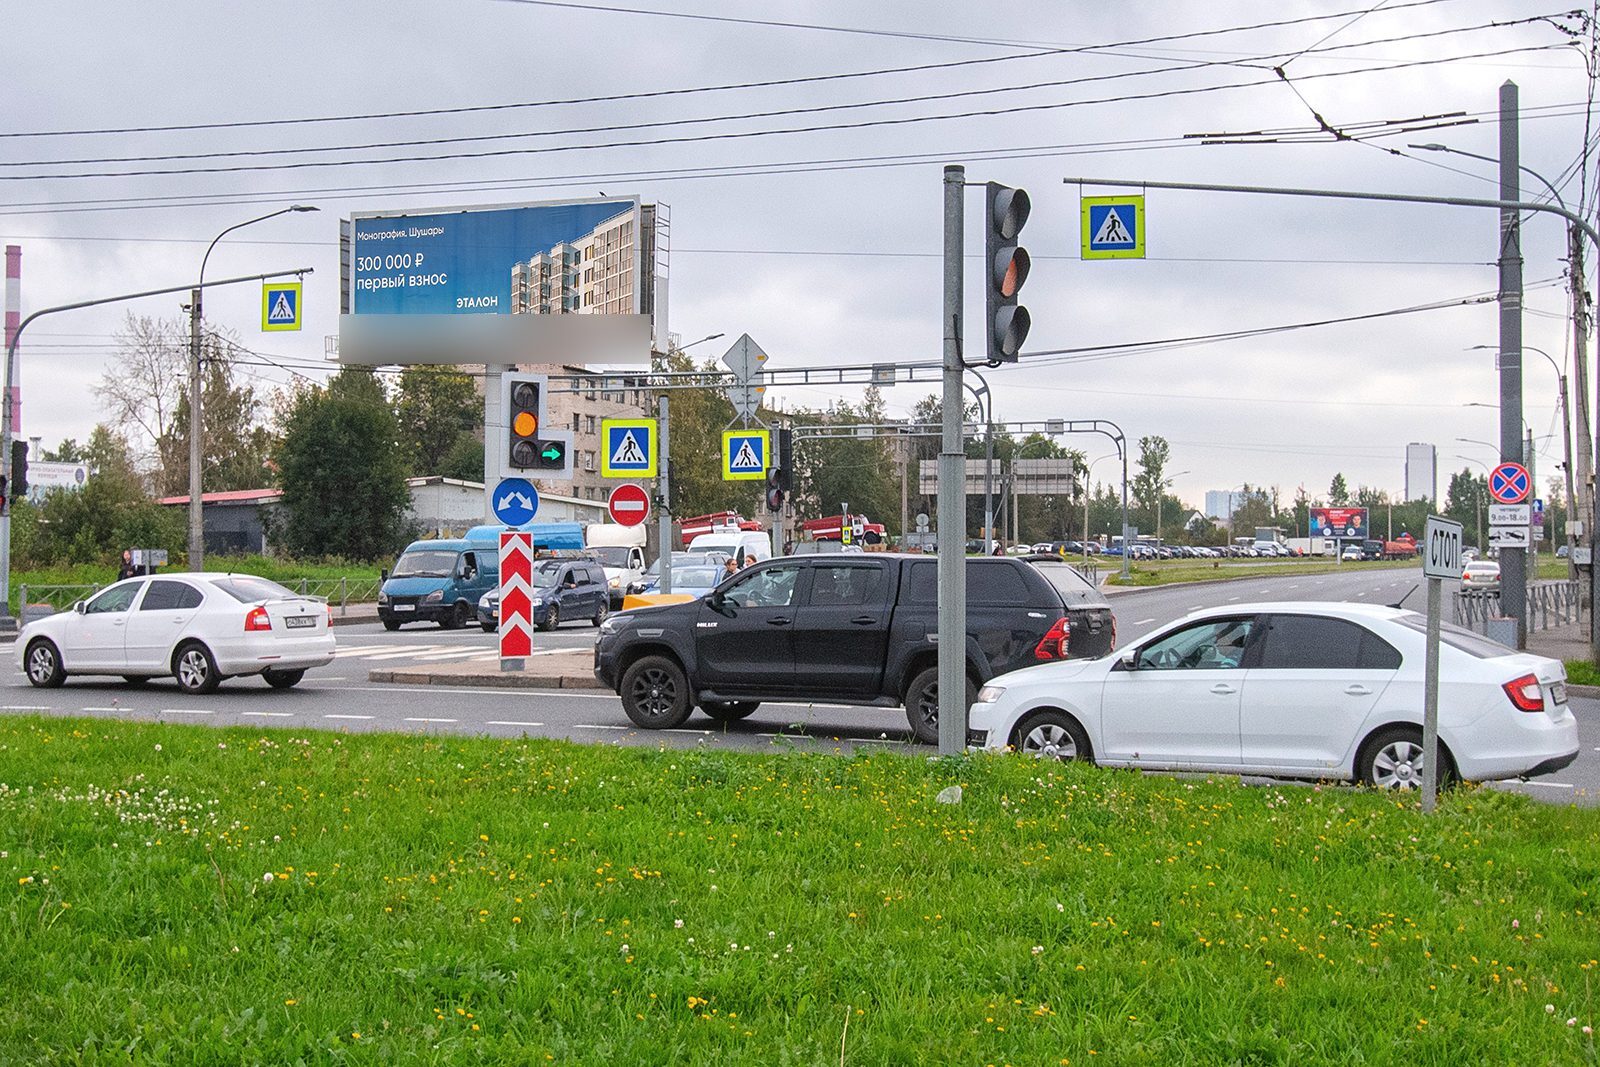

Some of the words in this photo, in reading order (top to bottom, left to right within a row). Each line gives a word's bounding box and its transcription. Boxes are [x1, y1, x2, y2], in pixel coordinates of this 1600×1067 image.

[357, 229, 407, 241] Монография.
[409, 226, 444, 238] Шушары
[357, 256, 382, 272] 300
[385, 254, 412, 270] 000
[415, 253, 424, 268] ₽
[357, 274, 405, 292] первый
[408, 273, 448, 287] взнос
[456, 296, 498, 309] ЭТАЛОН
[1432, 528, 1457, 569] СТОП
